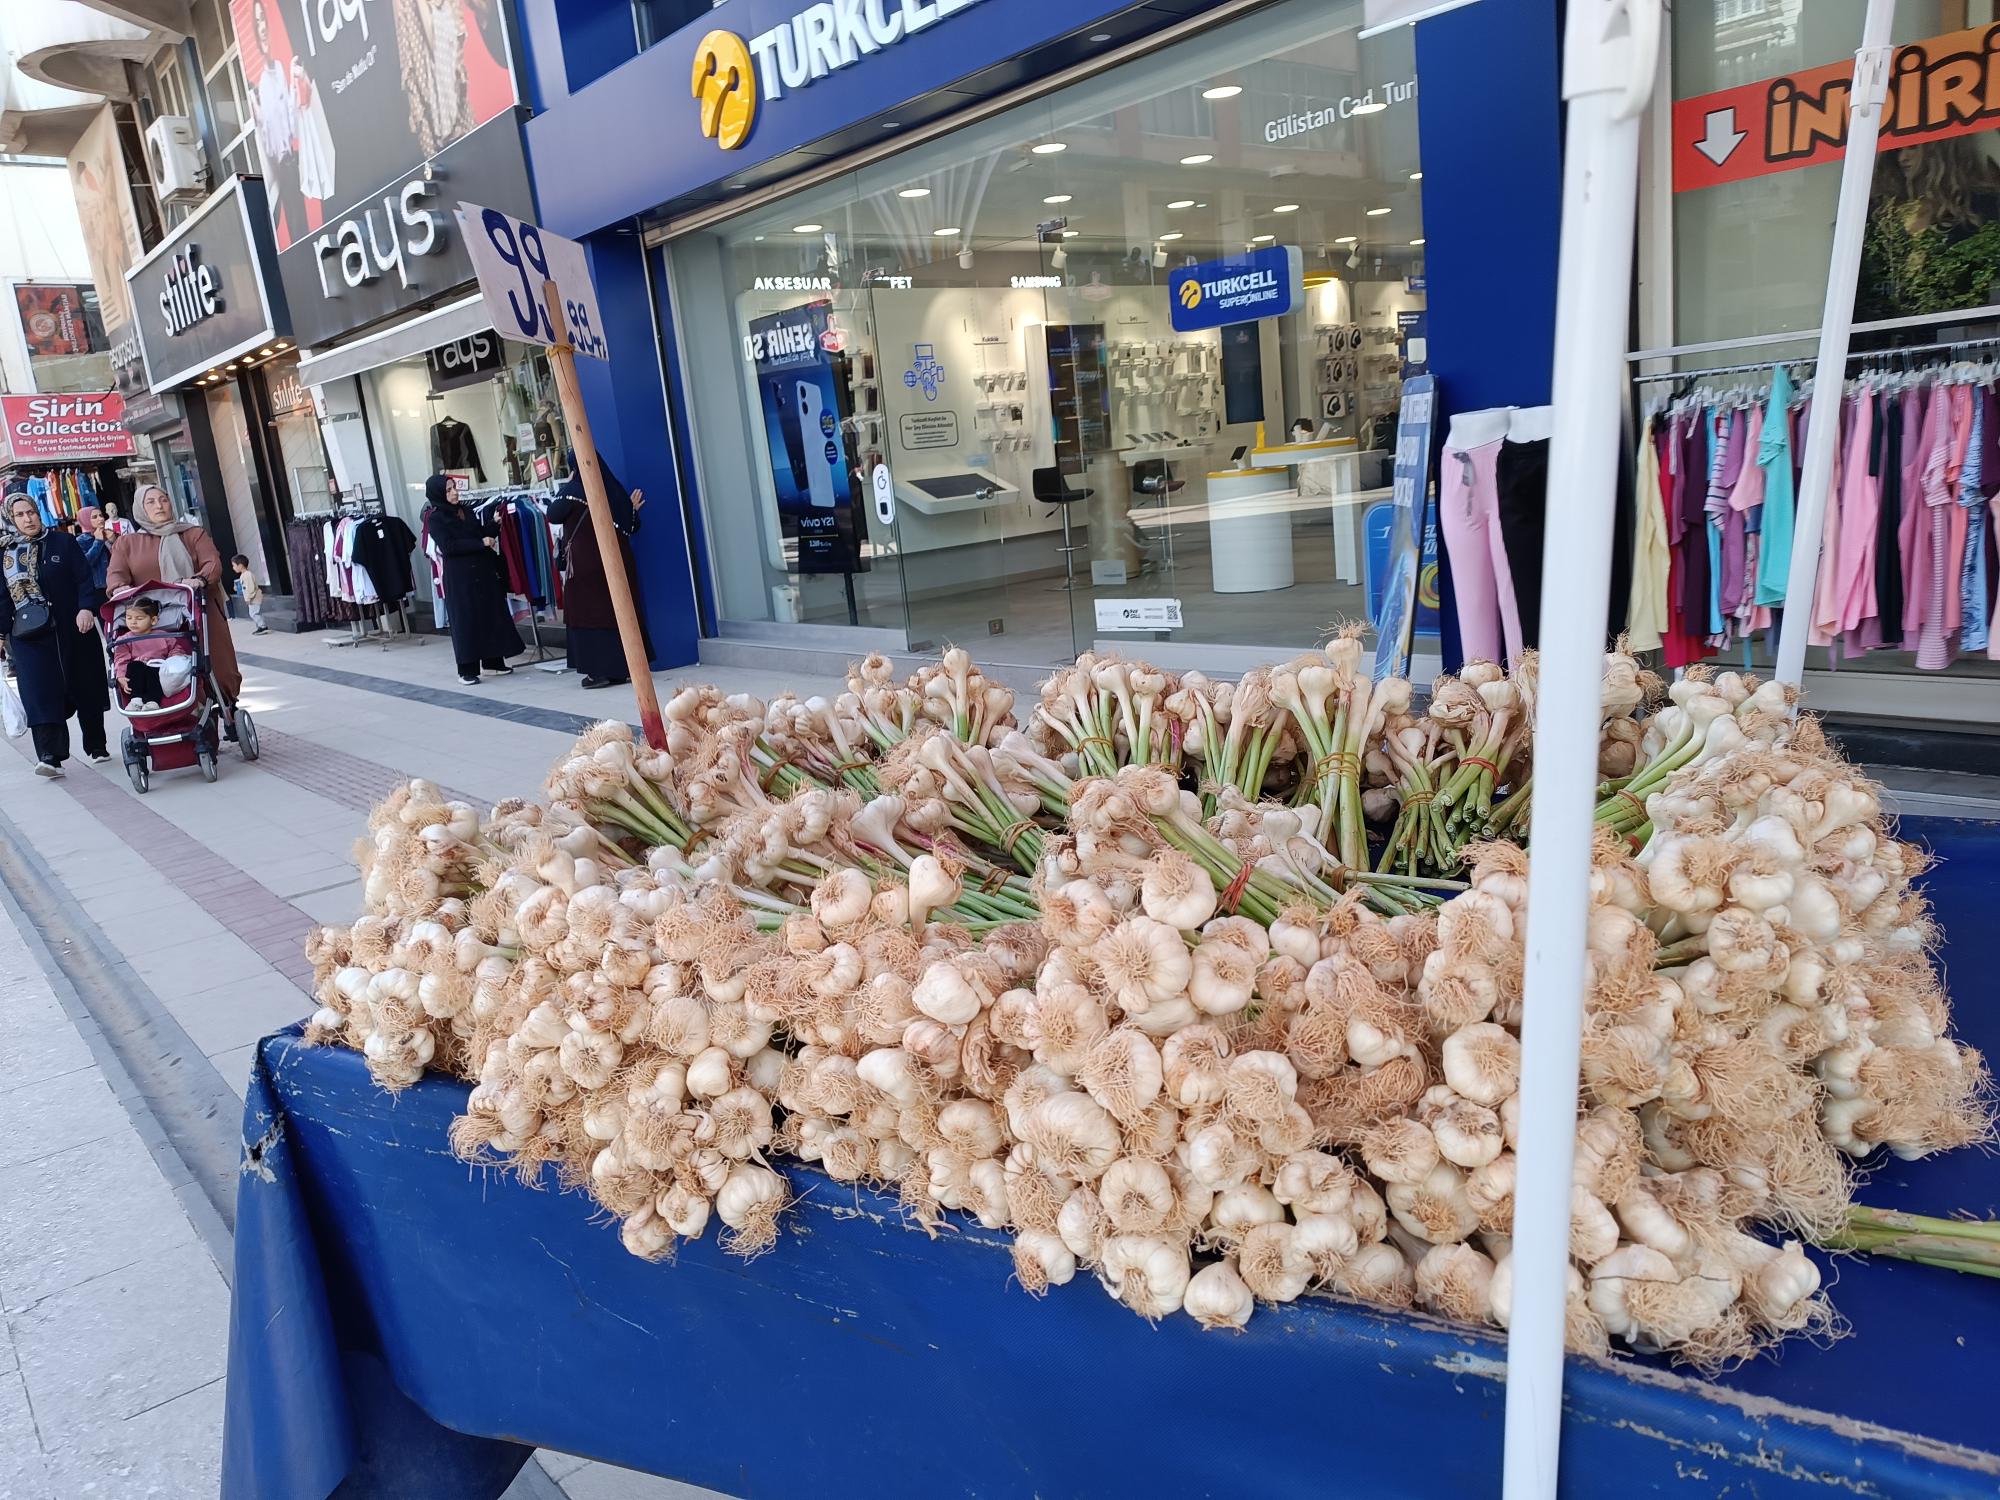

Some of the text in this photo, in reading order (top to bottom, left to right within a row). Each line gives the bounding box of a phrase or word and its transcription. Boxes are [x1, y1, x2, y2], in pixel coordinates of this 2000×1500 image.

[1264, 106, 1336, 143] Gülistan
[754, 276, 832, 290] AKSESUAR
[1202, 269, 1278, 299] TURKCELL
[1219, 288, 1279, 309] SUPERONLINE
[28, 397, 104, 423] Şirin
[15, 419, 122, 436] Collection
[801, 516, 835, 528] vivo Y21
